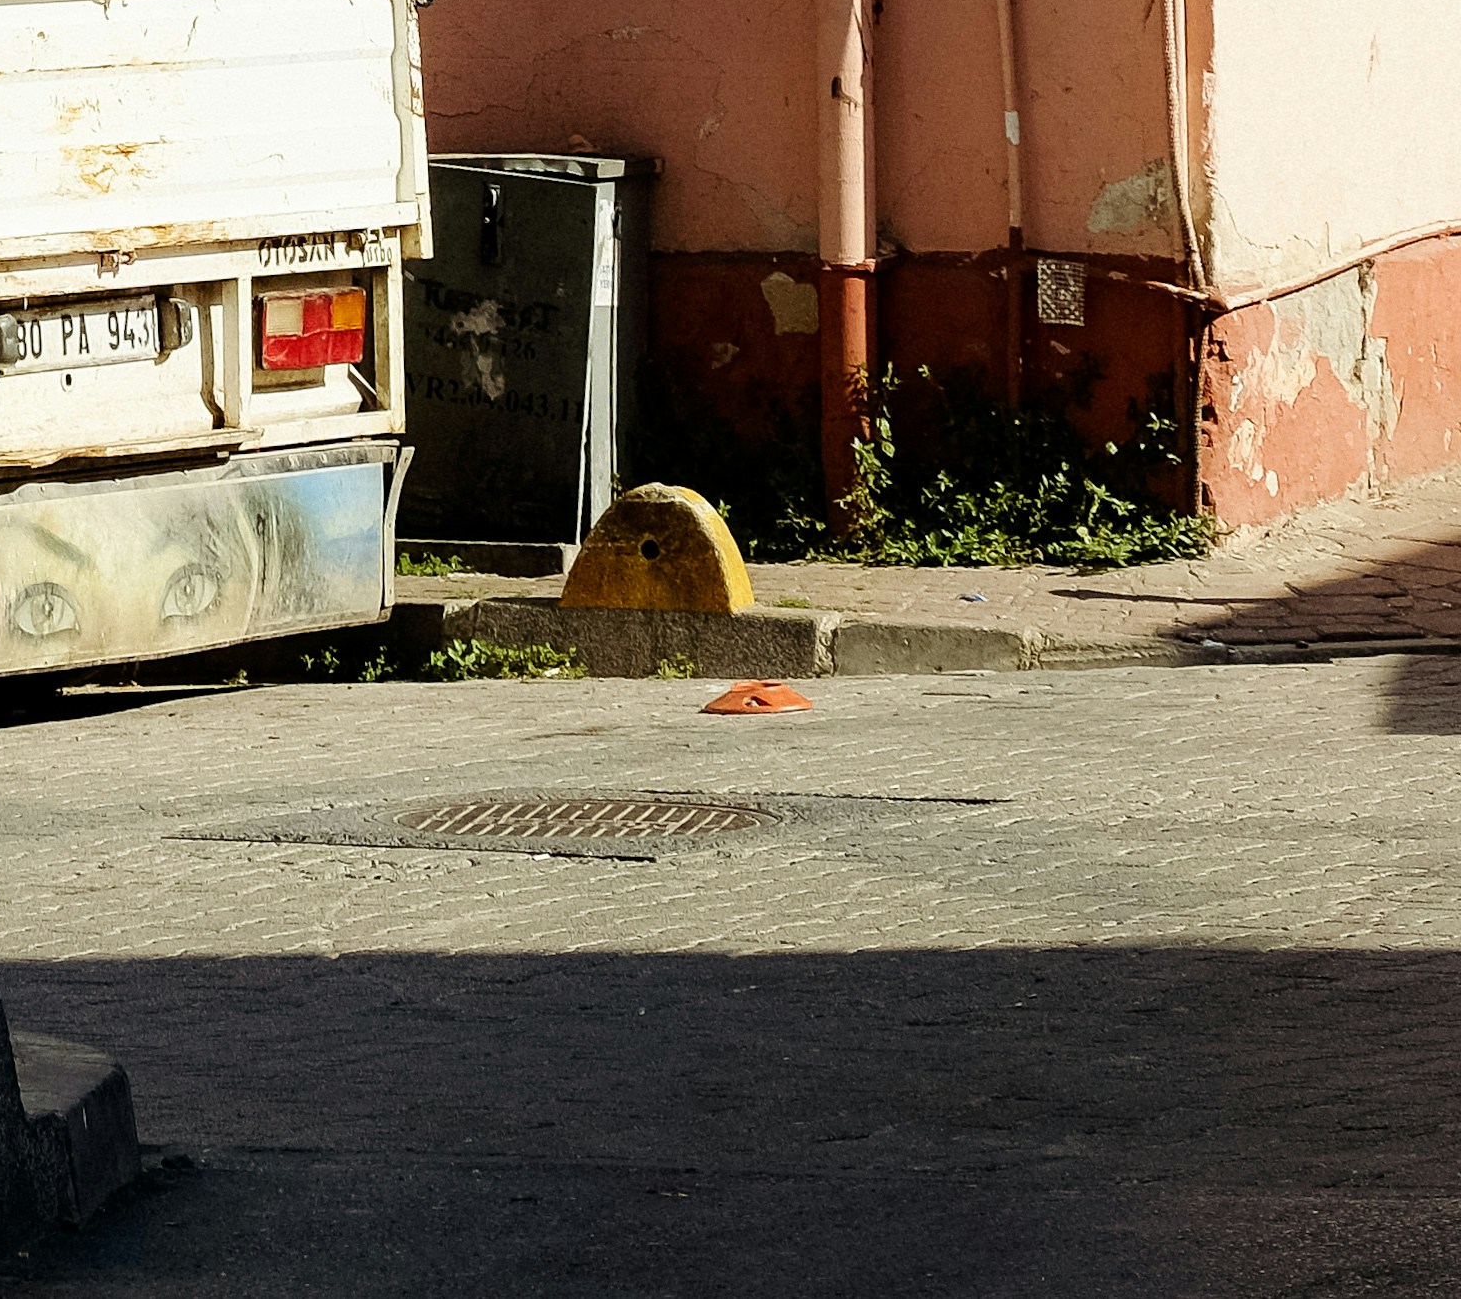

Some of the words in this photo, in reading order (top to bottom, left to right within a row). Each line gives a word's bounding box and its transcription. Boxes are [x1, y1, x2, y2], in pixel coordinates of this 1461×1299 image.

[258, 233, 337, 268] OTOSAN
[61, 313, 90, 356] PA
[108, 307, 150, 350] 943
